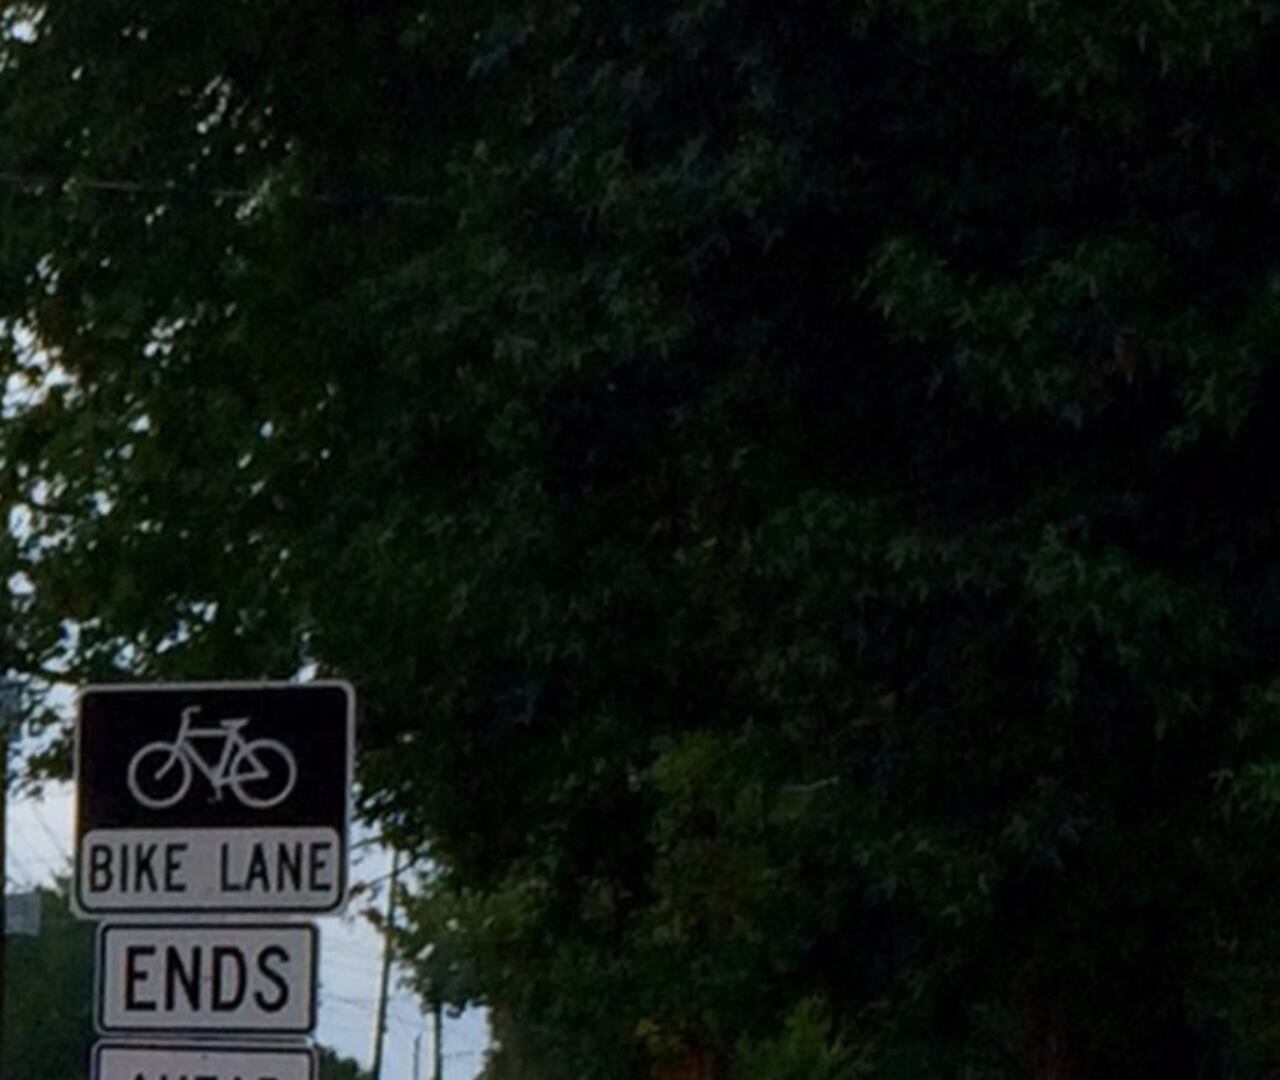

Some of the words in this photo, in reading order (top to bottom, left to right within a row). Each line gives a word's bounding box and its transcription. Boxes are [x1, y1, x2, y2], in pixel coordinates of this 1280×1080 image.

[89, 843, 187, 893] BIKE
[221, 842, 333, 893] LANE
[124, 946, 290, 1013] ENDS
